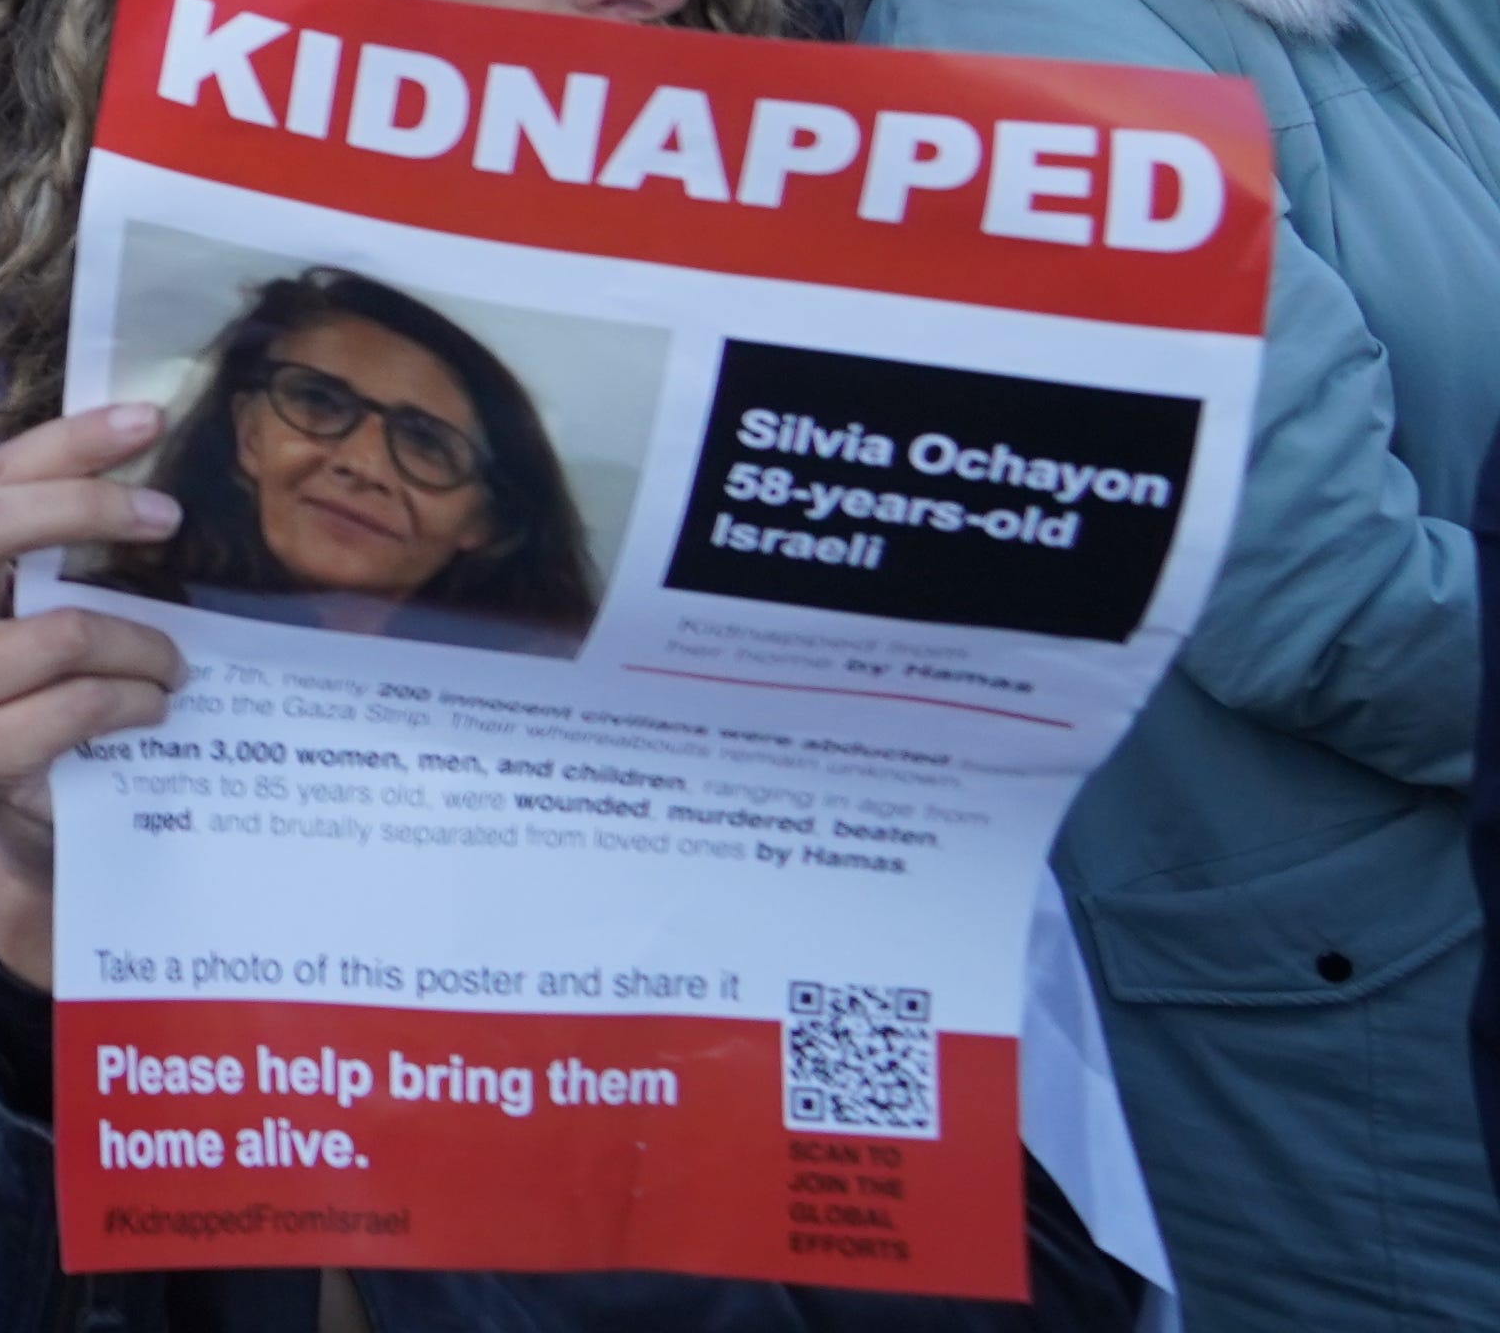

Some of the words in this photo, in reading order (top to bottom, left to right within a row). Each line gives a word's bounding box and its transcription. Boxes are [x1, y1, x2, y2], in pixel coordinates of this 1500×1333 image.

[737, 406, 894, 471] Silvia
[907, 430, 1172, 509] Ochayon
[723, 463, 1078, 548] 58-years-old
[710, 514, 883, 572] Israeli
[94, 948, 157, 987] Take
[164, 958, 184, 985] a
[191, 952, 286, 992] photo
[294, 952, 331, 987] of
[338, 954, 405, 991] this
[415, 961, 532, 1002] poster
[538, 965, 602, 1001] and
[611, 968, 713, 1004] share
[720, 970, 741, 1004] it
[96, 1043, 244, 1098] Please
[256, 1045, 372, 1105] help
[387, 1056, 534, 1116] bring
[546, 1057, 678, 1107] them
[98, 1120, 226, 1174] home
[235, 1121, 370, 1174] alive.
